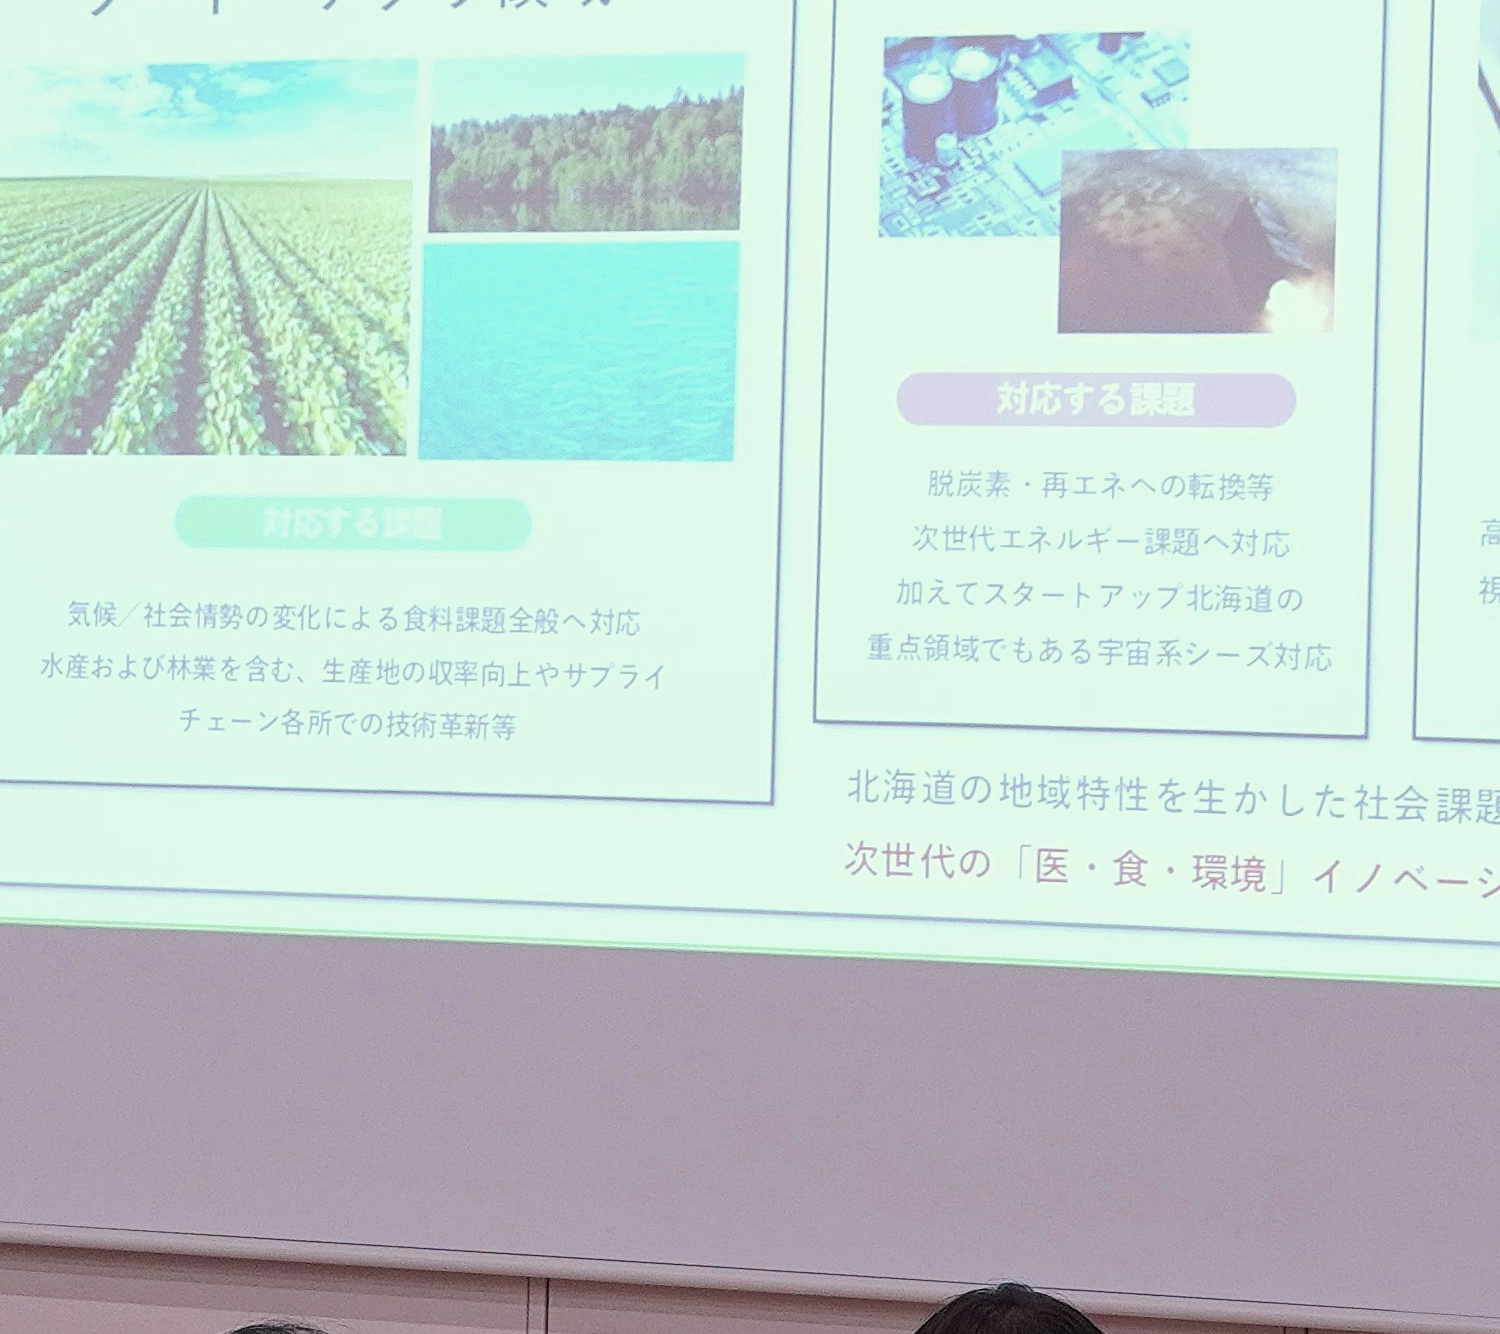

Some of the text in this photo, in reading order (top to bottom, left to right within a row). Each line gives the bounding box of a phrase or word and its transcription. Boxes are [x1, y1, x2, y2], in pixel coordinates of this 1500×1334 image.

[996, 380, 1197, 417] 対応する課題
[927, 470, 1275, 502] 脱炭素・再エネへの転換等
[912, 524, 1291, 557] 次世代エネルギー課題へ対応
[896, 578, 1303, 613] 加えてスタートアップ北海道の
[179, 707, 517, 742] チェーン各所での技術革新等
